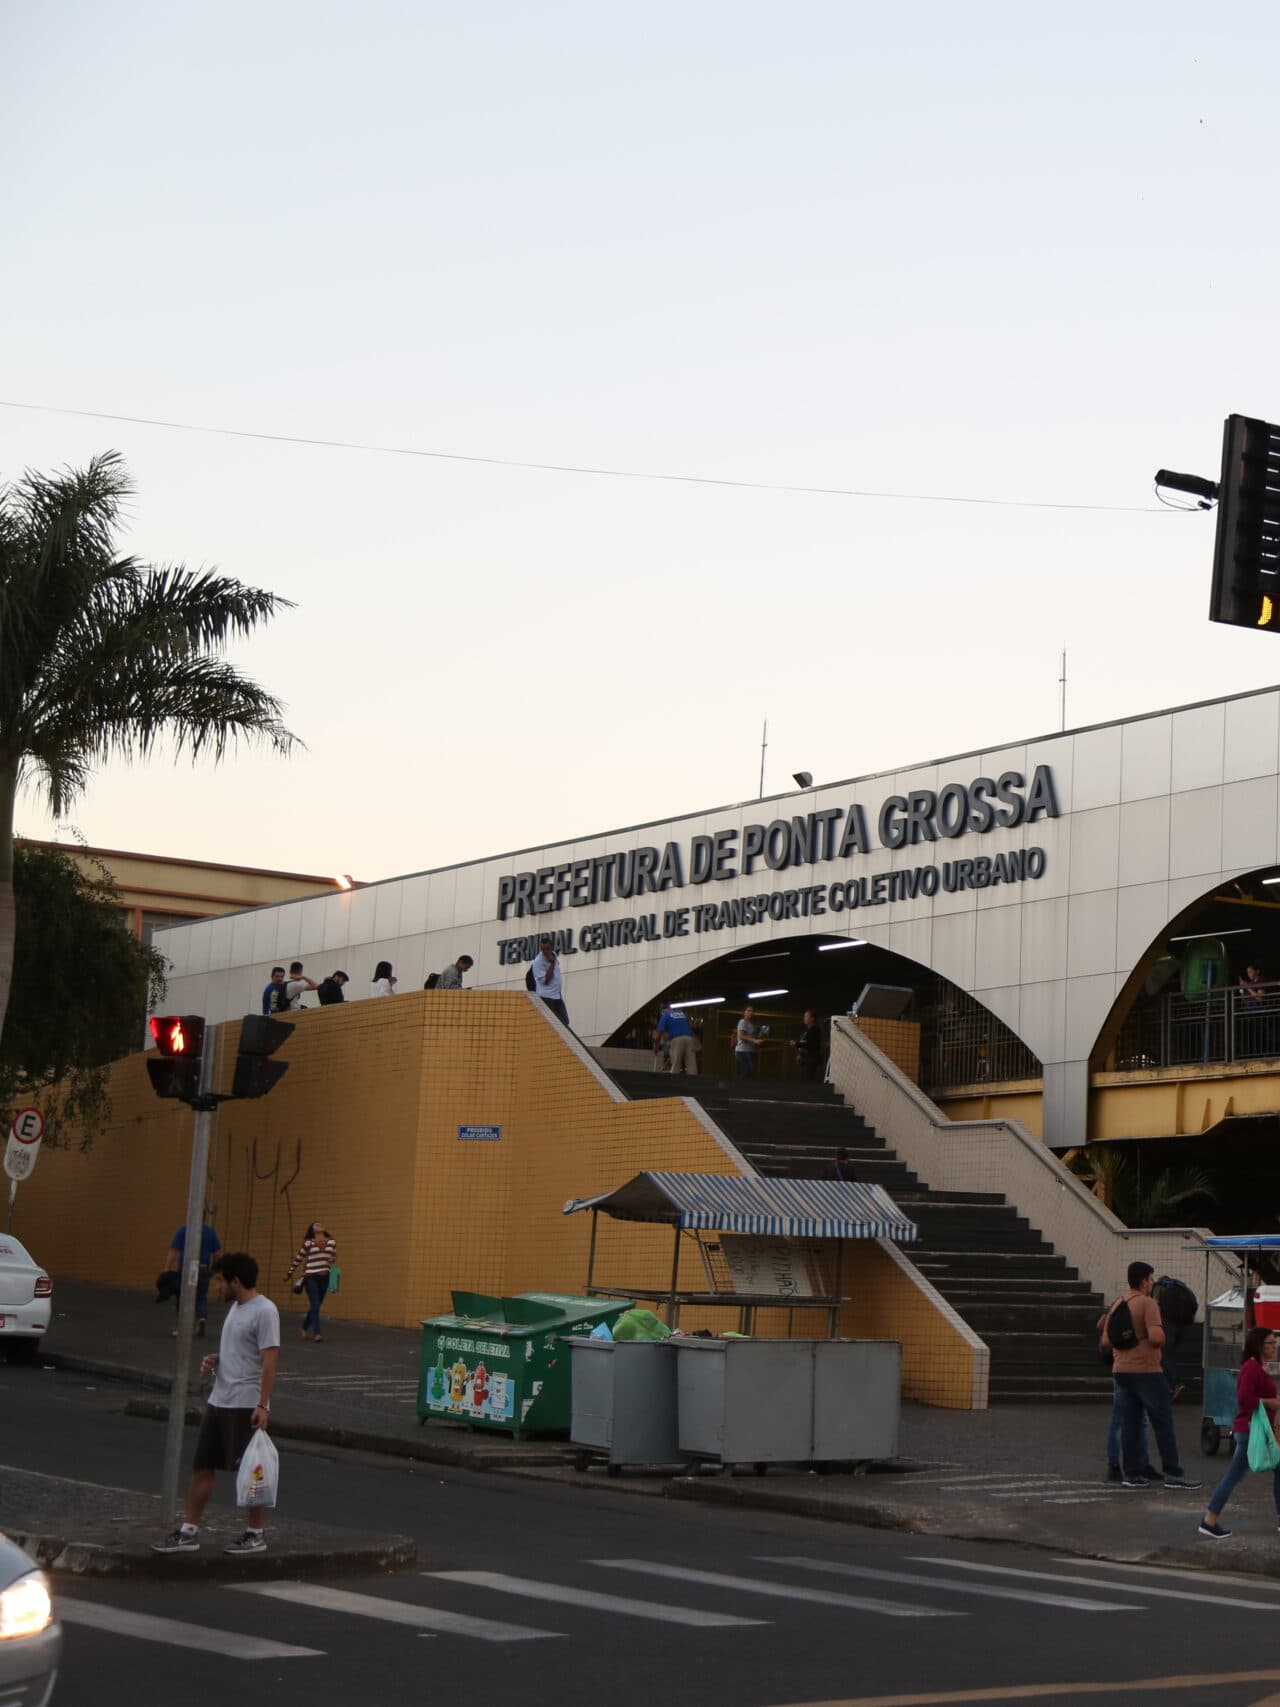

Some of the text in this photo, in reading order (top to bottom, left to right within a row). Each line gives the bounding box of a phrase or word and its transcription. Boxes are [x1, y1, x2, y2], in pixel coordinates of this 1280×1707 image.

[497, 765, 1060, 921] PREFEITURA DE PONTA GROSSA
[579, 912, 661, 952] CENTRAL
[663, 908, 689, 938] DE
[693, 883, 827, 933] TRANSPORTE
[829, 863, 938, 912] COLETIVO
[943, 845, 1047, 893] URBANO
[20, 1114, 37, 1137] E
[446, 1337, 510, 1358] COLETA SELETIVA
